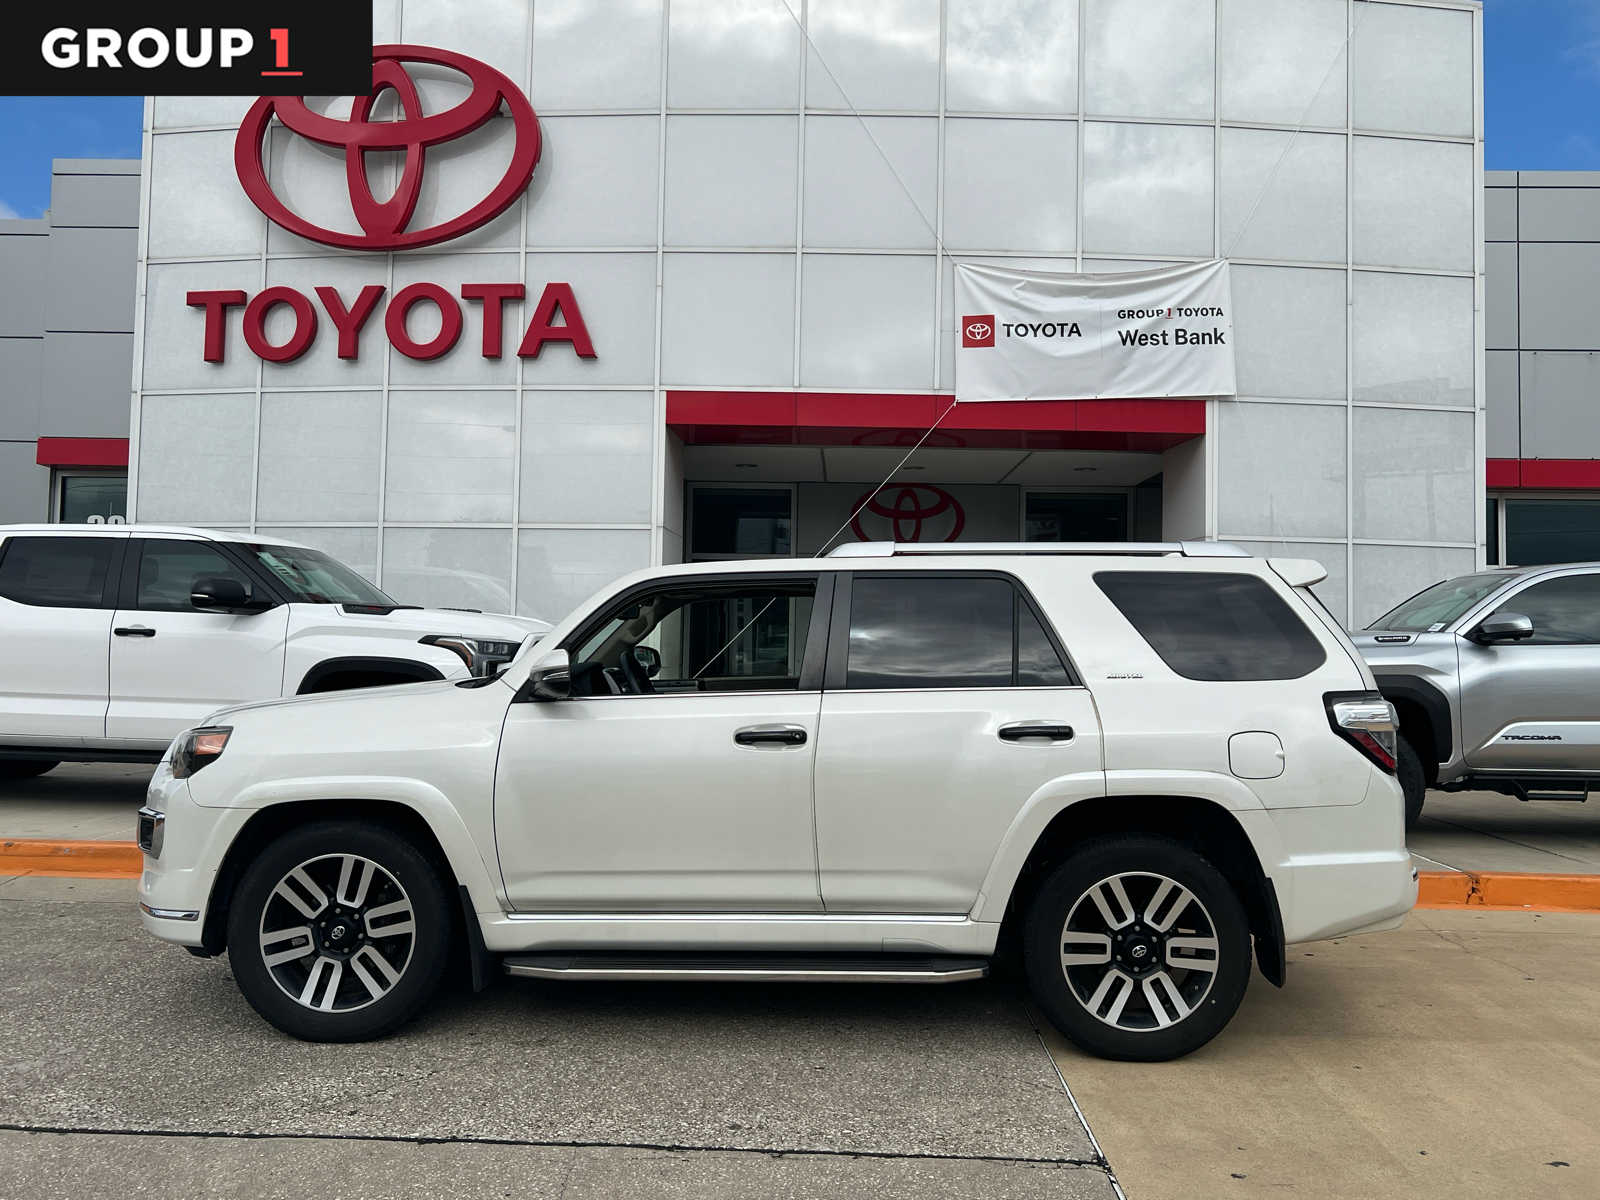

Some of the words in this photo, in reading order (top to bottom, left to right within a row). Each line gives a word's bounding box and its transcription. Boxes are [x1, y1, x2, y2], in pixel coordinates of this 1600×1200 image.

[1117, 309, 1164, 319] GROUP
[1177, 307, 1224, 317] TOYOTA
[186, 282, 598, 363] TOYOTA
[1002, 322, 1082, 338] TOYOTA
[1117, 329, 1169, 346] West
[1174, 328, 1226, 346] Bank
